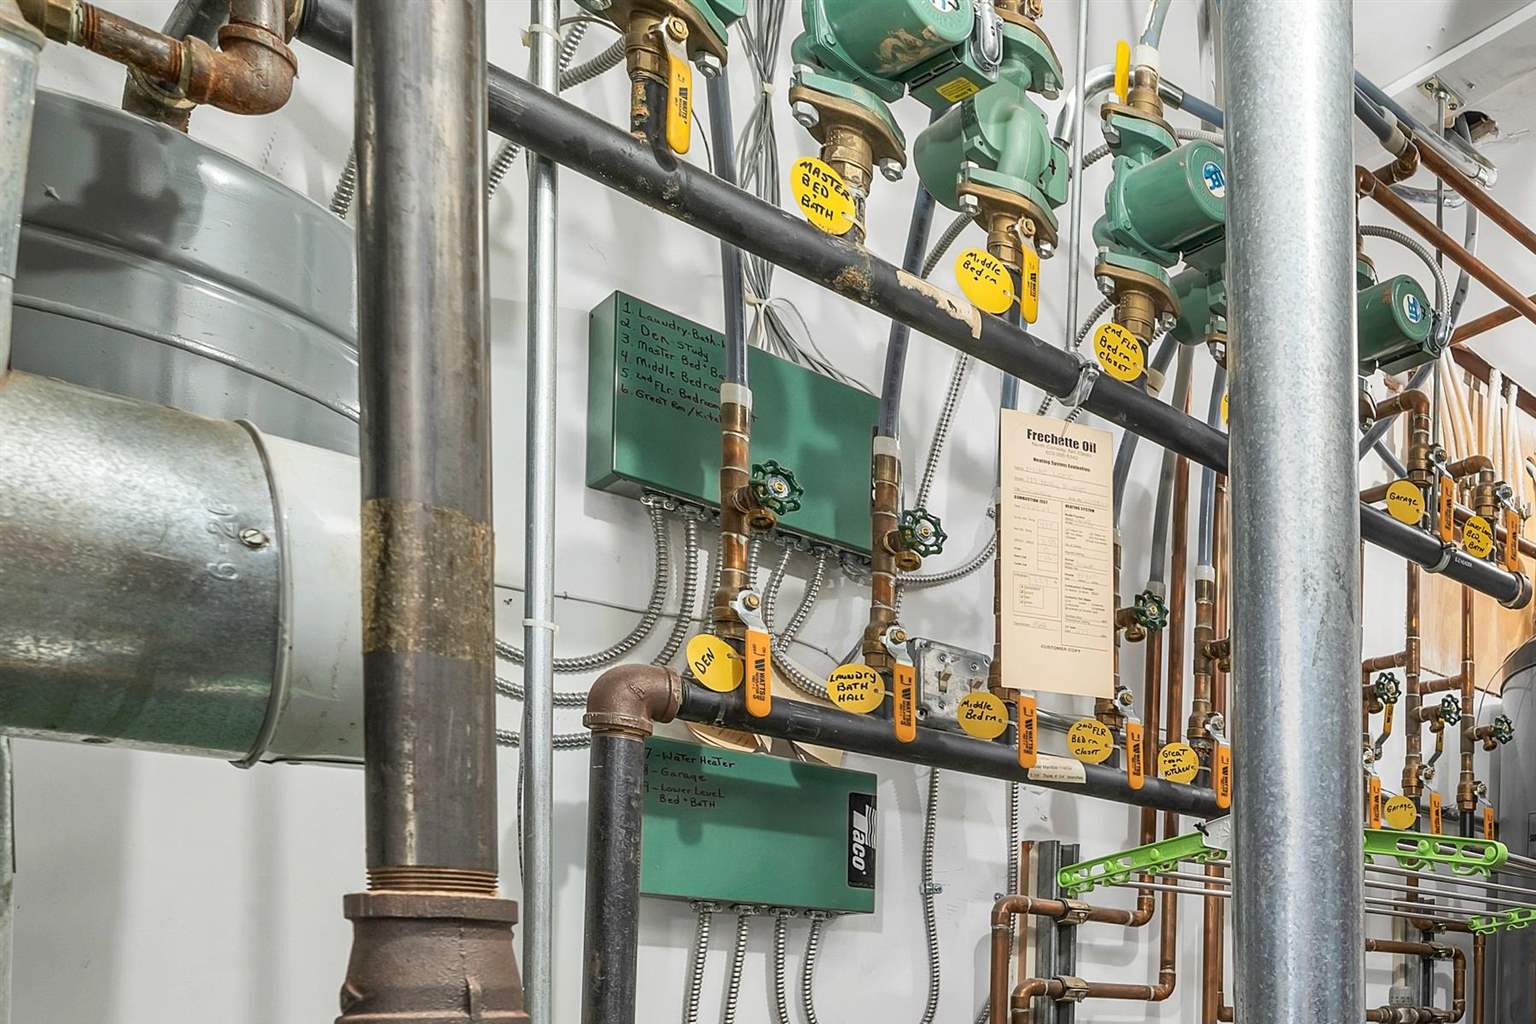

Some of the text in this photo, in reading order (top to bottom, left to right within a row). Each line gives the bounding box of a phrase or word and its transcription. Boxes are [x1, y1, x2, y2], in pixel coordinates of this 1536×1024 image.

[800, 161, 850, 201] MASTER
[801, 173, 829, 198] BED
[801, 194, 834, 221] BATH
[962, 260, 984, 277] Bed
[965, 252, 1001, 276] Middle
[640, 323, 670, 345] Den
[1104, 326, 1138, 354] 2nd FLR
[1099, 335, 1119, 354] Bed
[636, 356, 675, 378] Middle
[681, 372, 721, 393] Bedroo
[1026, 428, 1080, 450] Frechette
[1082, 440, 1097, 454] Oil
[1389, 492, 1418, 506] Garage
[695, 647, 715, 675] DEN
[837, 682, 868, 692] BATH
[838, 693, 865, 702] HALL
[960, 699, 993, 711] Middle
[965, 708, 984, 720] Bed
[1092, 727, 1107, 737] FLR
[661, 767, 707, 783] Garage
[659, 794, 680, 805] Bed
[1386, 803, 1413, 813] Garage
